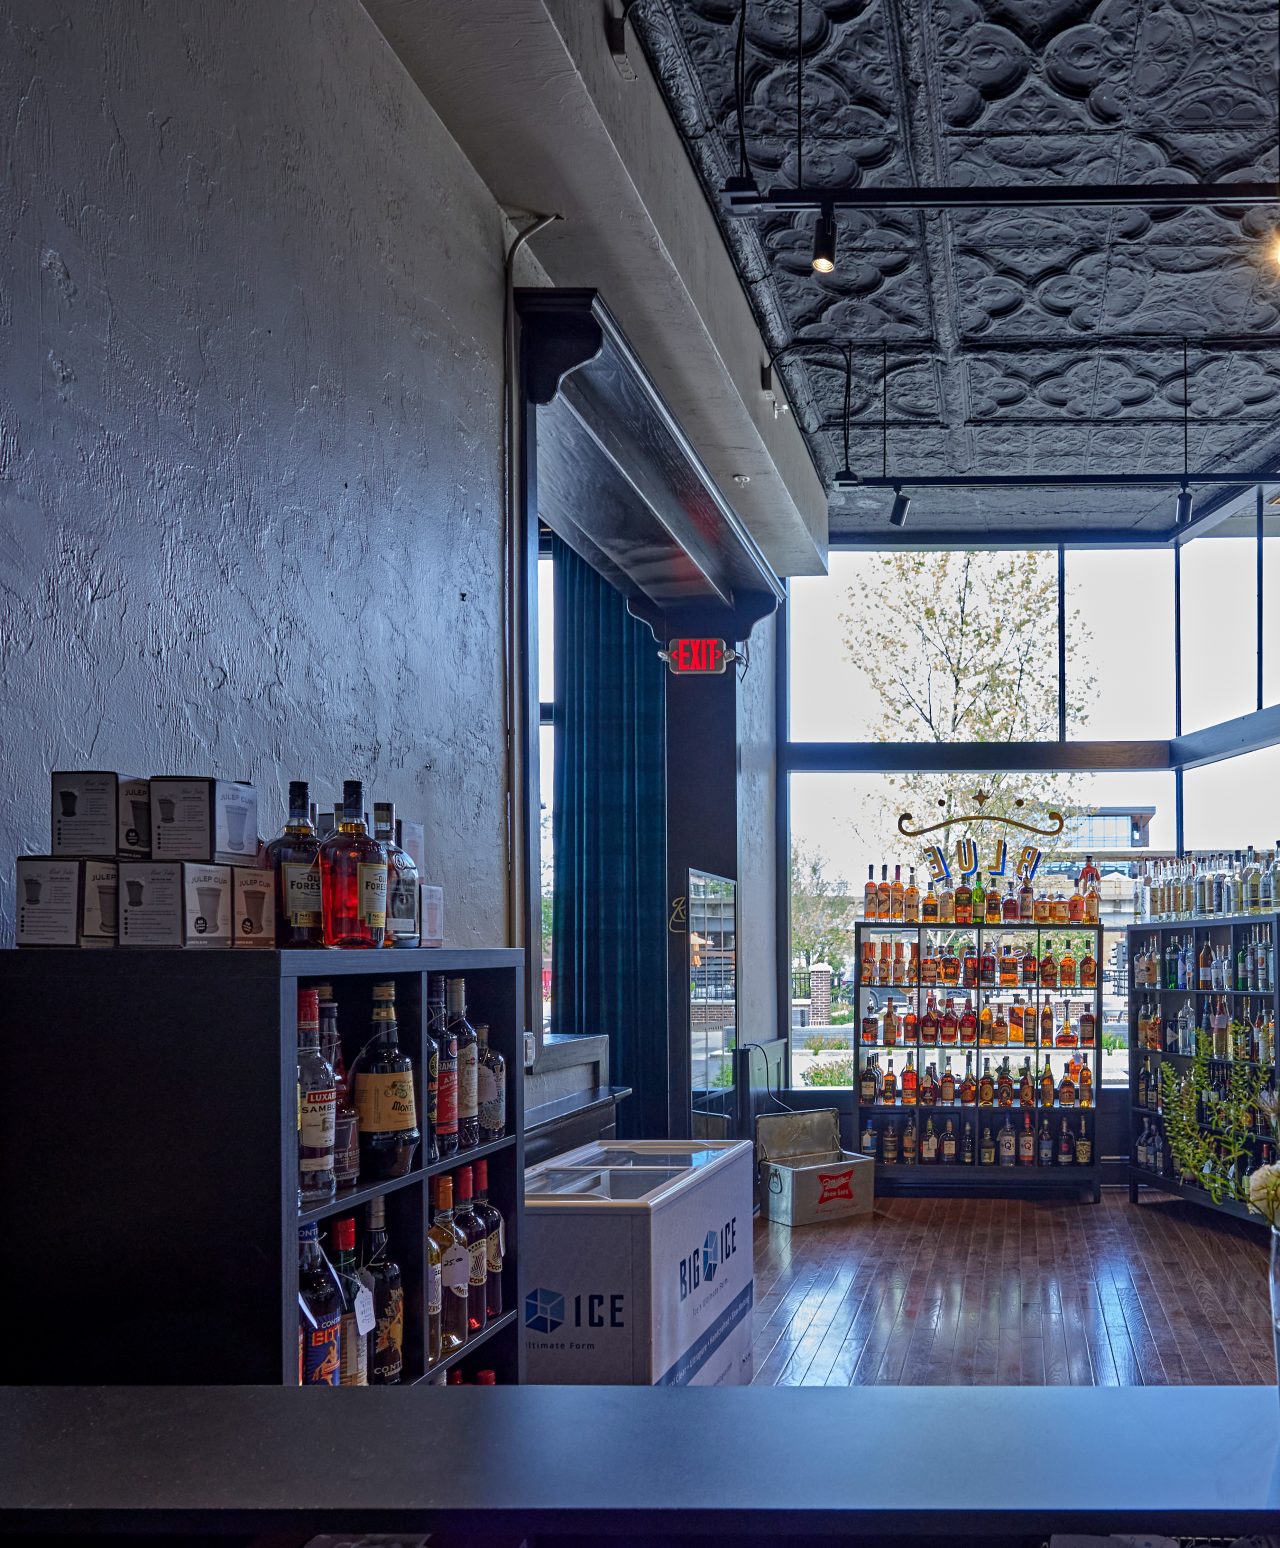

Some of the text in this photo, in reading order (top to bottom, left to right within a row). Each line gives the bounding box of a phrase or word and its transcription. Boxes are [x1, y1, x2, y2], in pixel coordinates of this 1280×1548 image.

[679, 639, 718, 671] EXIT
[191, 875, 213, 884] JULEP
[239, 879, 258, 887] JULEP
[679, 1216, 737, 1302] BIG ICE
[575, 1294, 625, 1328] ICE
[526, 1341, 596, 1350] ltimate Form
